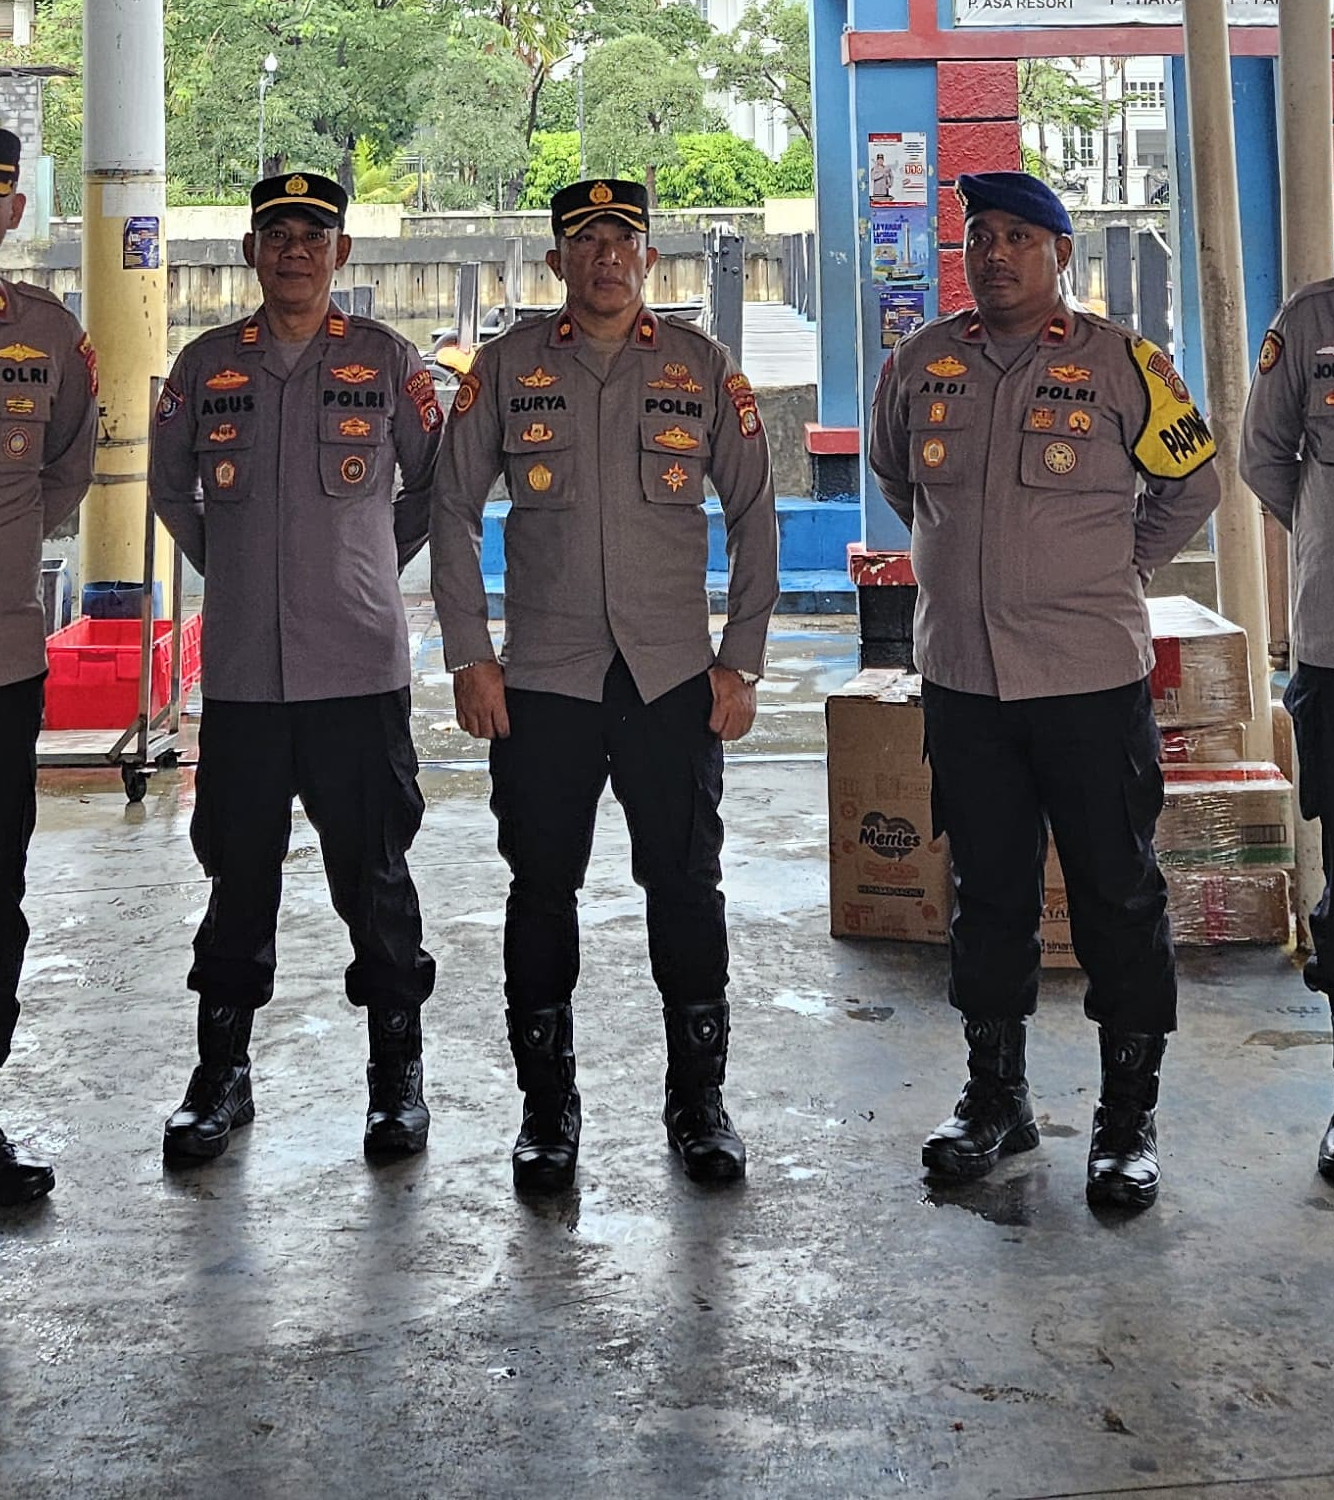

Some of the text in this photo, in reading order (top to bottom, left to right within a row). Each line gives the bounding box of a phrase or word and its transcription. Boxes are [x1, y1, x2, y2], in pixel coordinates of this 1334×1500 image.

[919, 381, 966, 396] ARDI
[1035, 385, 1097, 403] POLRI
[201, 394, 255, 416] AGUS
[323, 389, 385, 409] POLRI
[510, 395, 567, 413] SURYA
[645, 398, 703, 419] POLRI
[858, 827, 922, 848] Merries
